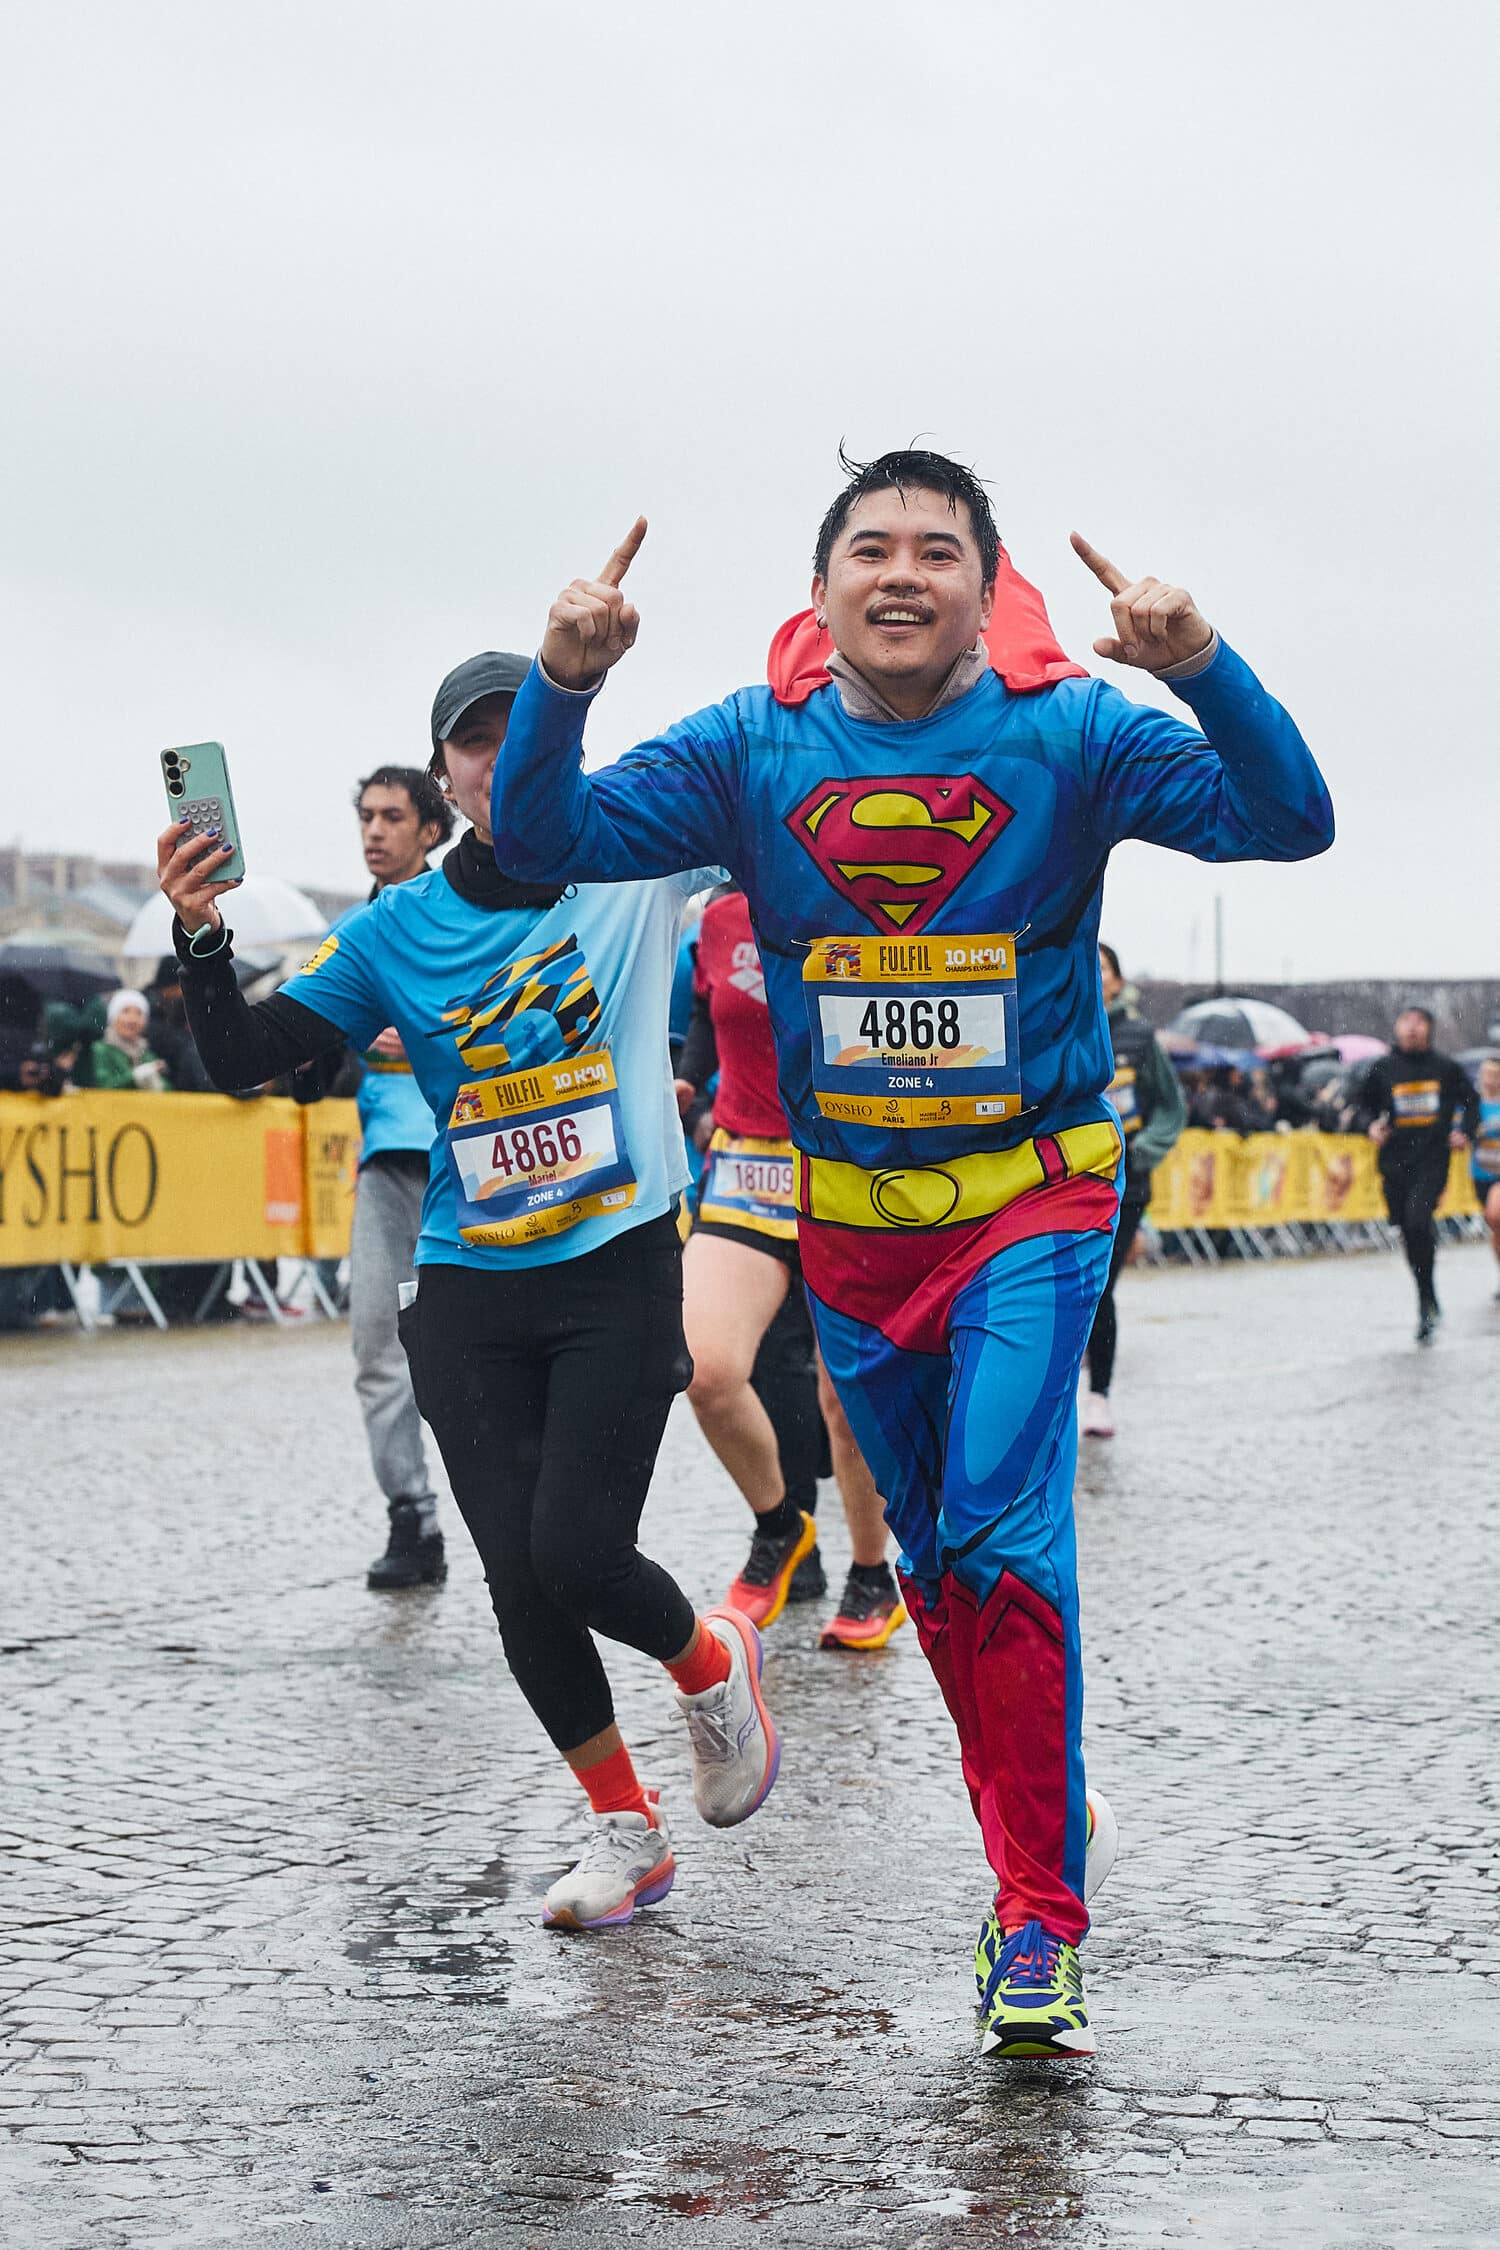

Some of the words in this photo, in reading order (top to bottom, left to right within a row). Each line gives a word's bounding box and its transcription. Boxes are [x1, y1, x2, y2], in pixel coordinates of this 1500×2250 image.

[879, 945, 932, 971] FULFIL
[945, 949, 966, 965] 10
[859, 999, 961, 1050] 4868
[881, 1052, 927, 1067] Emeliano
[930, 1053, 939, 1066] Jr
[552, 1073, 572, 1089] 10
[888, 1076, 922, 1089] ZONE
[925, 1077, 934, 1088] 4
[495, 1077, 545, 1107] FULFIL
[825, 1101, 873, 1117] OYSHO
[981, 1104, 989, 1112] M
[882, 1115, 905, 1124] PARIS
[492, 1118, 582, 1177] 4866
[528, 1171, 557, 1186] Mariel
[736, 1164, 793, 1194] 18109
[527, 1190, 554, 1206] ZONE
[556, 1188, 564, 1197] 4
[471, 1227, 515, 1244] OYSHO
[524, 1227, 547, 1239] PARIS
